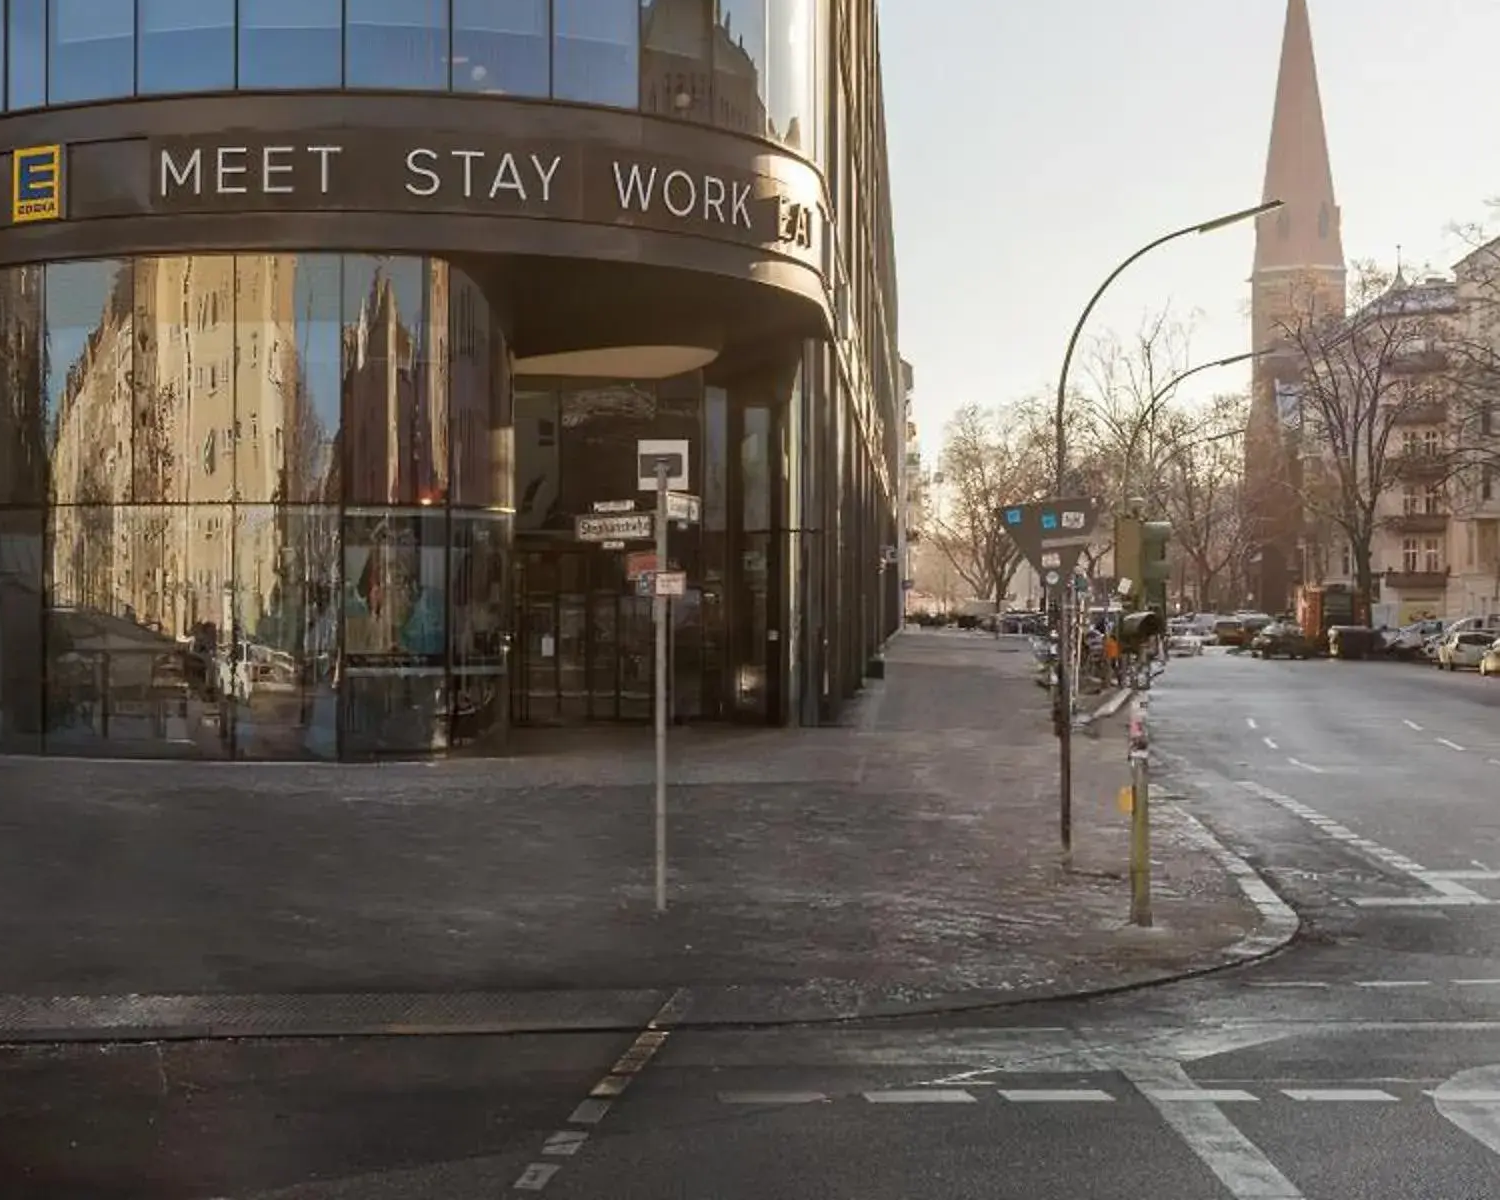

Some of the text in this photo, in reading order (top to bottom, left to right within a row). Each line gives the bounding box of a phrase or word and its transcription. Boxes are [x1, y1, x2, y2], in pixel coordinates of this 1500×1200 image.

[19, 152, 55, 200] E
[159, 146, 342, 197] MEET
[405, 148, 561, 201] STAY
[613, 161, 752, 229] WORK
